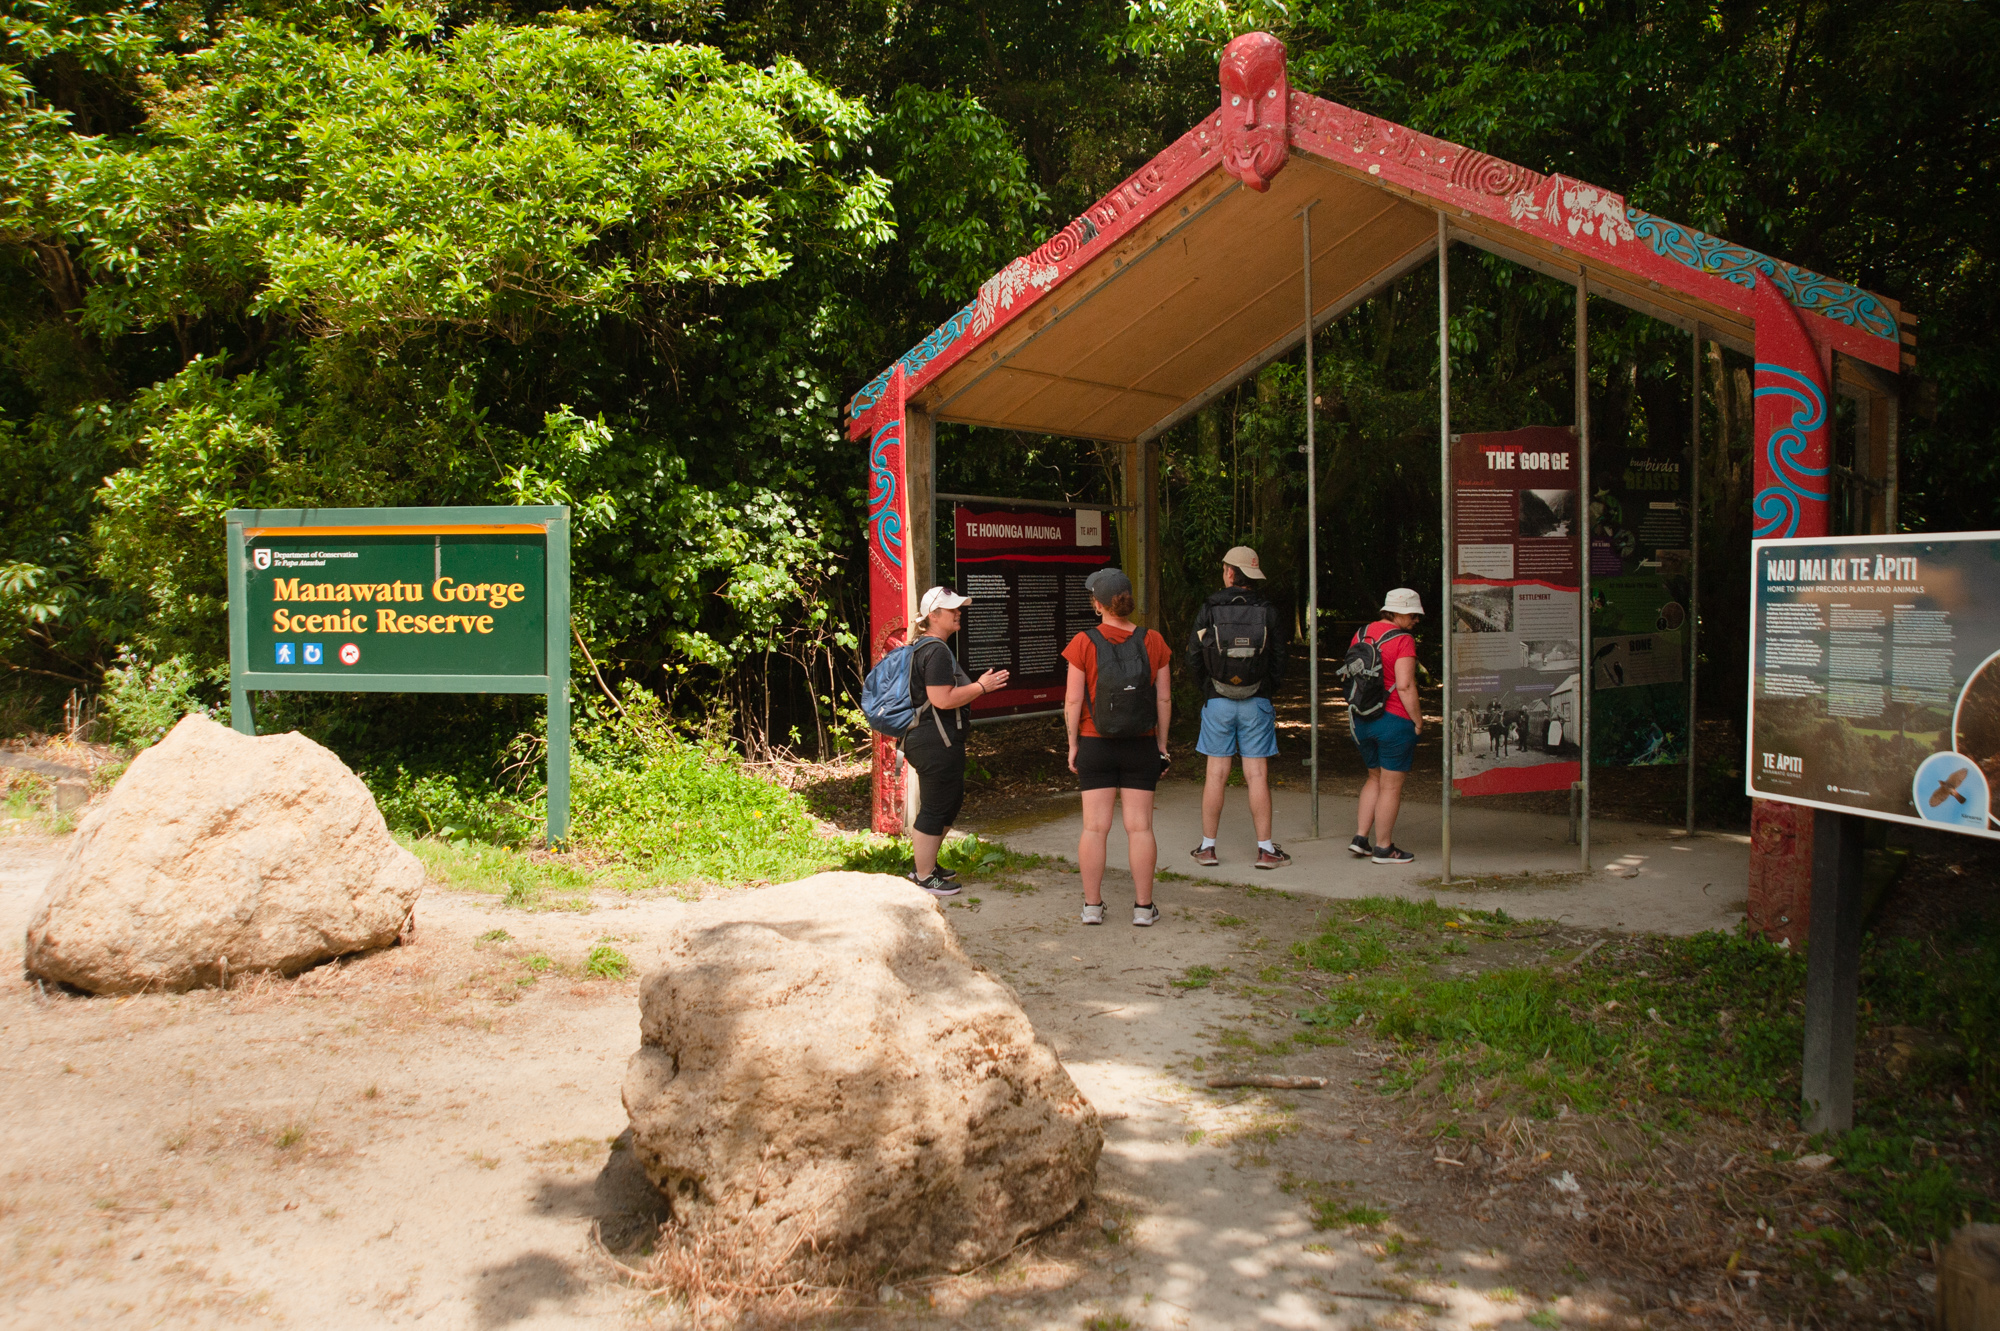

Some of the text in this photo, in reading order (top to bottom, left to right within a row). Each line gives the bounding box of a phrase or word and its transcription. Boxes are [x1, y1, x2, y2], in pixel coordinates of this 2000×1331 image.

[1486, 452, 1570, 471] THE GORGE
[1645, 457, 1673, 472] birds
[966, 522, 1062, 540] TE HONONGA MAUNGA
[1080, 526, 1086, 535] TE
[274, 551, 359, 561] Department of Conservation
[274, 559, 282, 567] Te
[282, 559, 299, 569] Papa
[1767, 554, 1918, 581] NAU MAI KI TE ĀPITI
[273, 577, 525, 609] Manawatu Gorge
[1518, 593, 1551, 601] SETTLEMENT
[1892, 586, 1925, 594] ANIMALS
[273, 609, 494, 634] Scenic Reserve
[1762, 752, 1804, 773] TE ĀPITI
